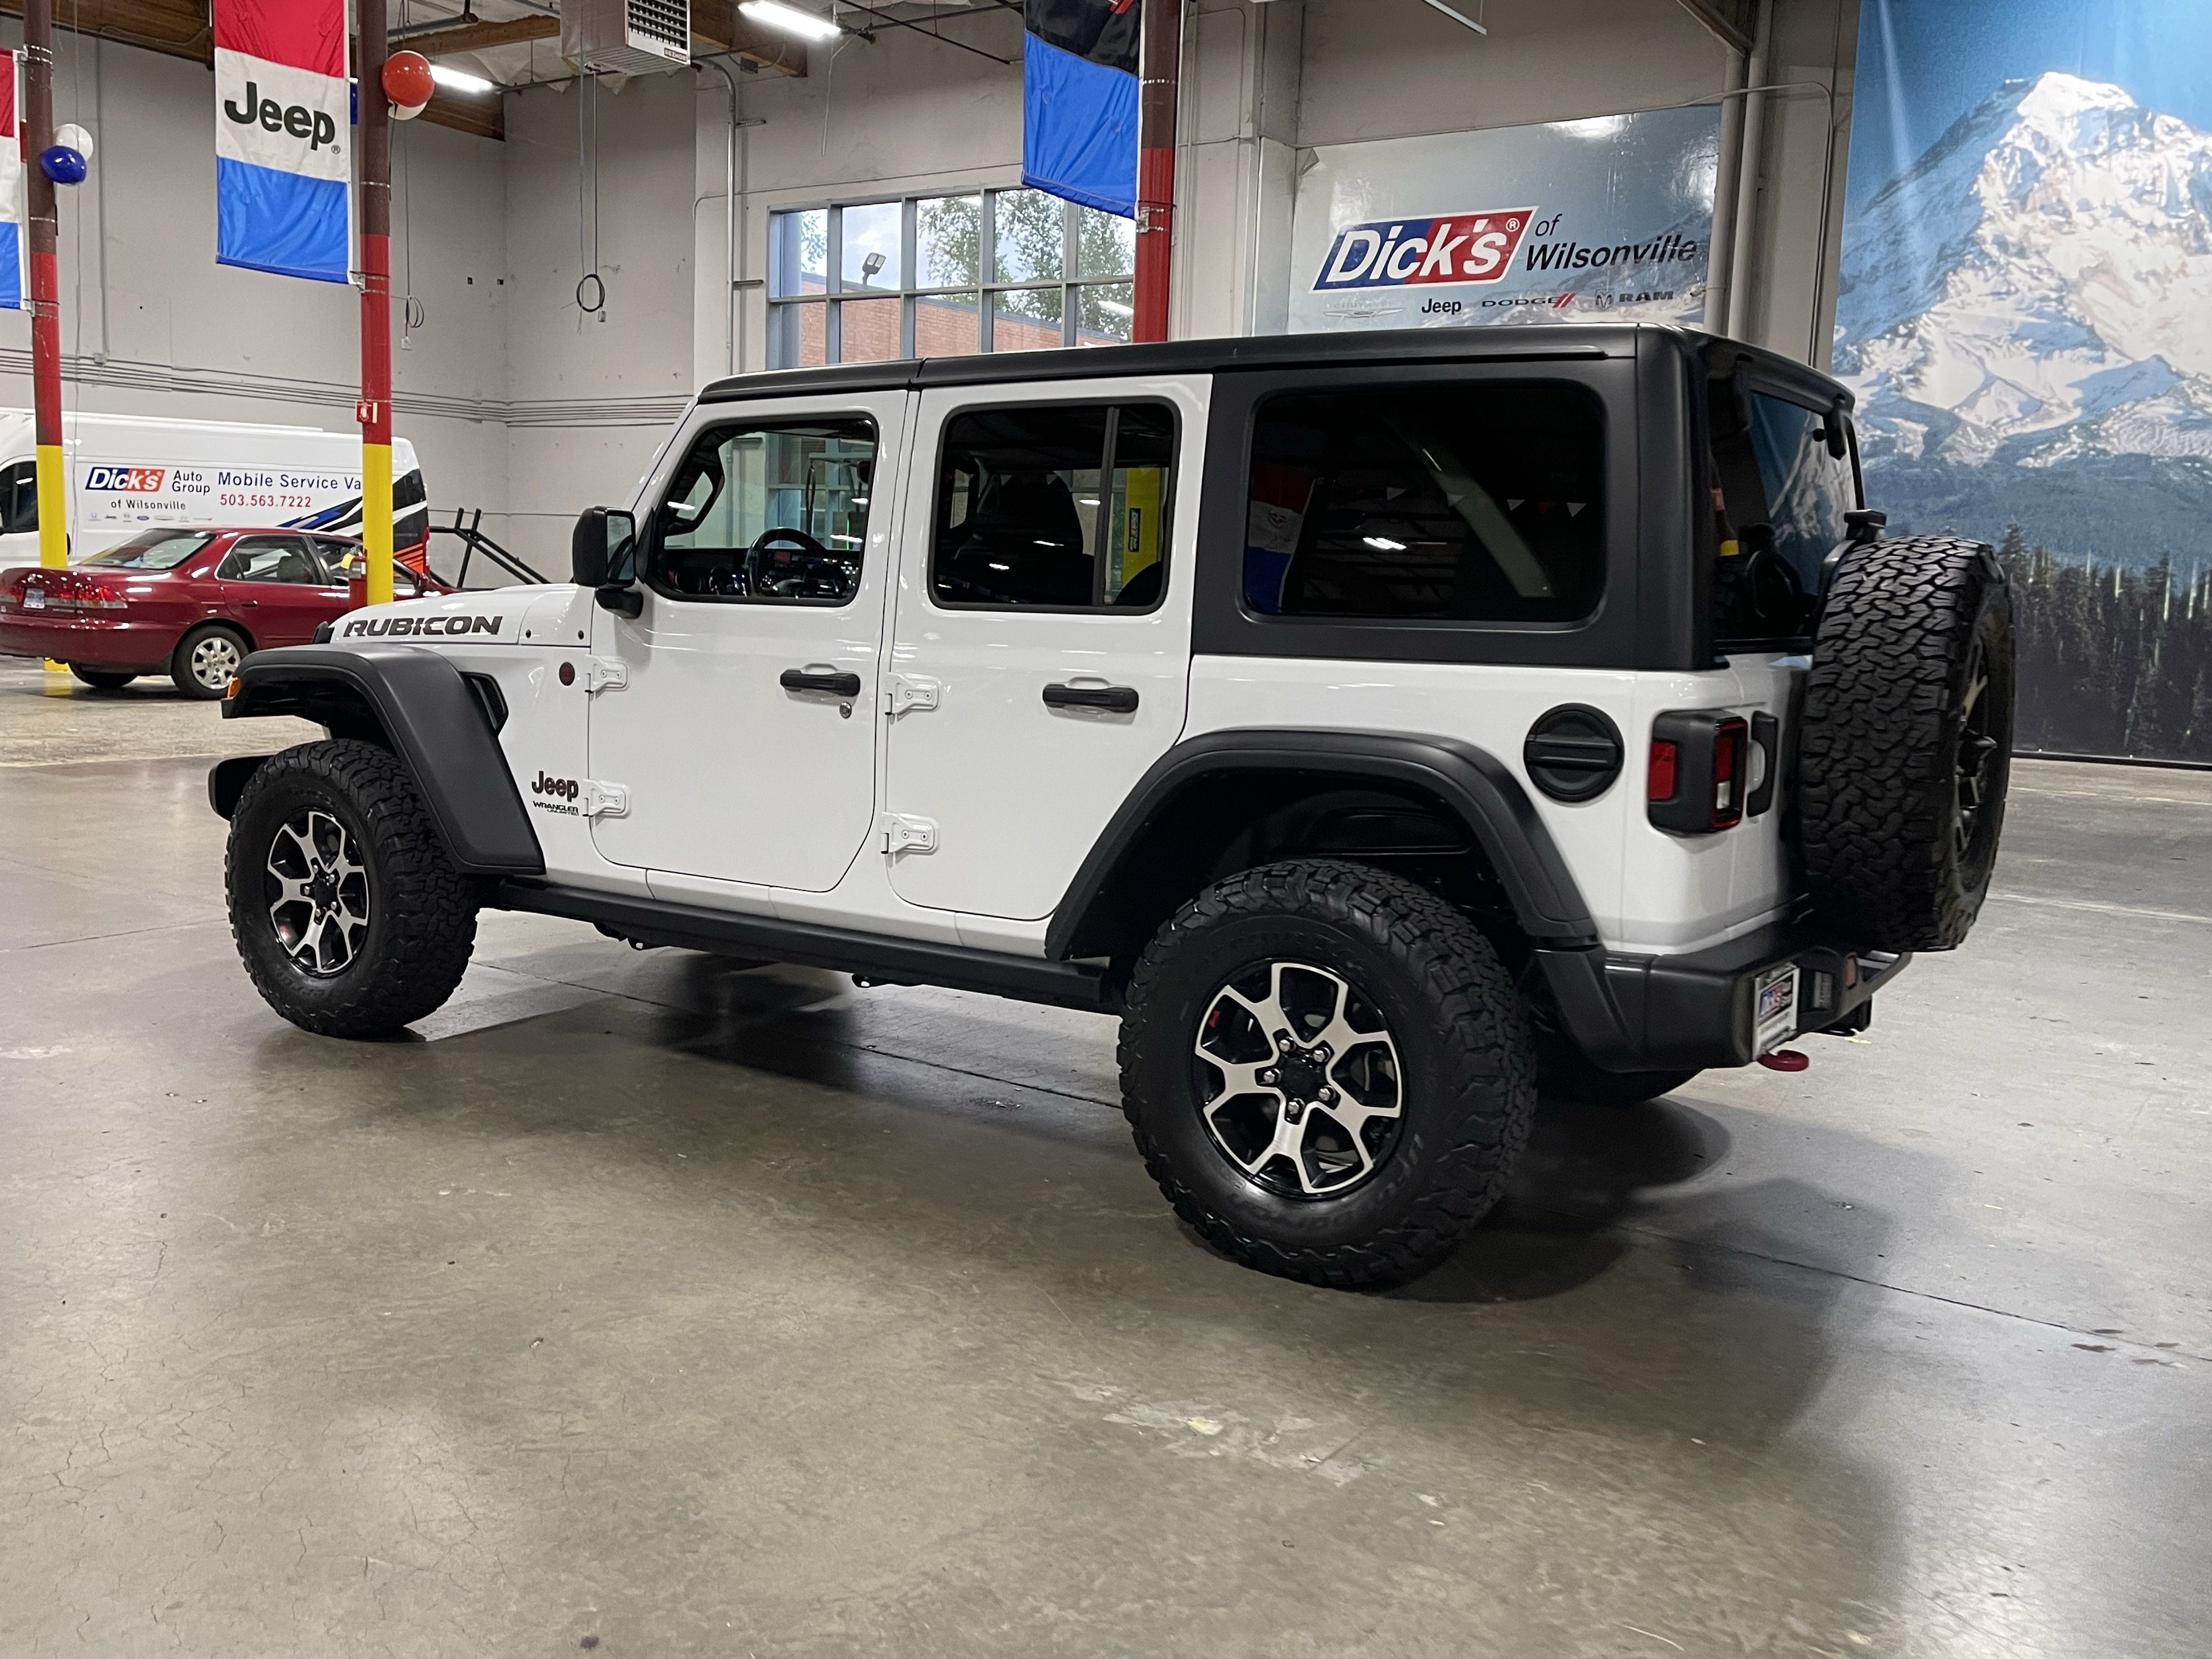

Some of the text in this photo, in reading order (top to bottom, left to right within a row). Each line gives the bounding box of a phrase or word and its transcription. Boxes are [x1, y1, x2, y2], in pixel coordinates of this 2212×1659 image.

[224, 81, 335, 151] Jeep
[1535, 213, 1562, 236] of
[1325, 219, 1507, 283] Dick's
[1526, 234, 1697, 270] Wilsonville
[1482, 296, 1561, 307] DODGE
[1619, 290, 1674, 303] RAM
[1421, 298, 1462, 315] Jeep
[89, 469, 160, 490] Dick's
[173, 470, 202, 482] Auto
[218, 472, 361, 490] Mobile Service Va
[172, 481, 211, 495] Group
[111, 499, 186, 510] of Wilsonville
[219, 494, 311, 507] 503.563.7222
[343, 616, 503, 637] RUBICON
[532, 770, 578, 802] Jeep
[532, 800, 578, 812] WRANGLER
